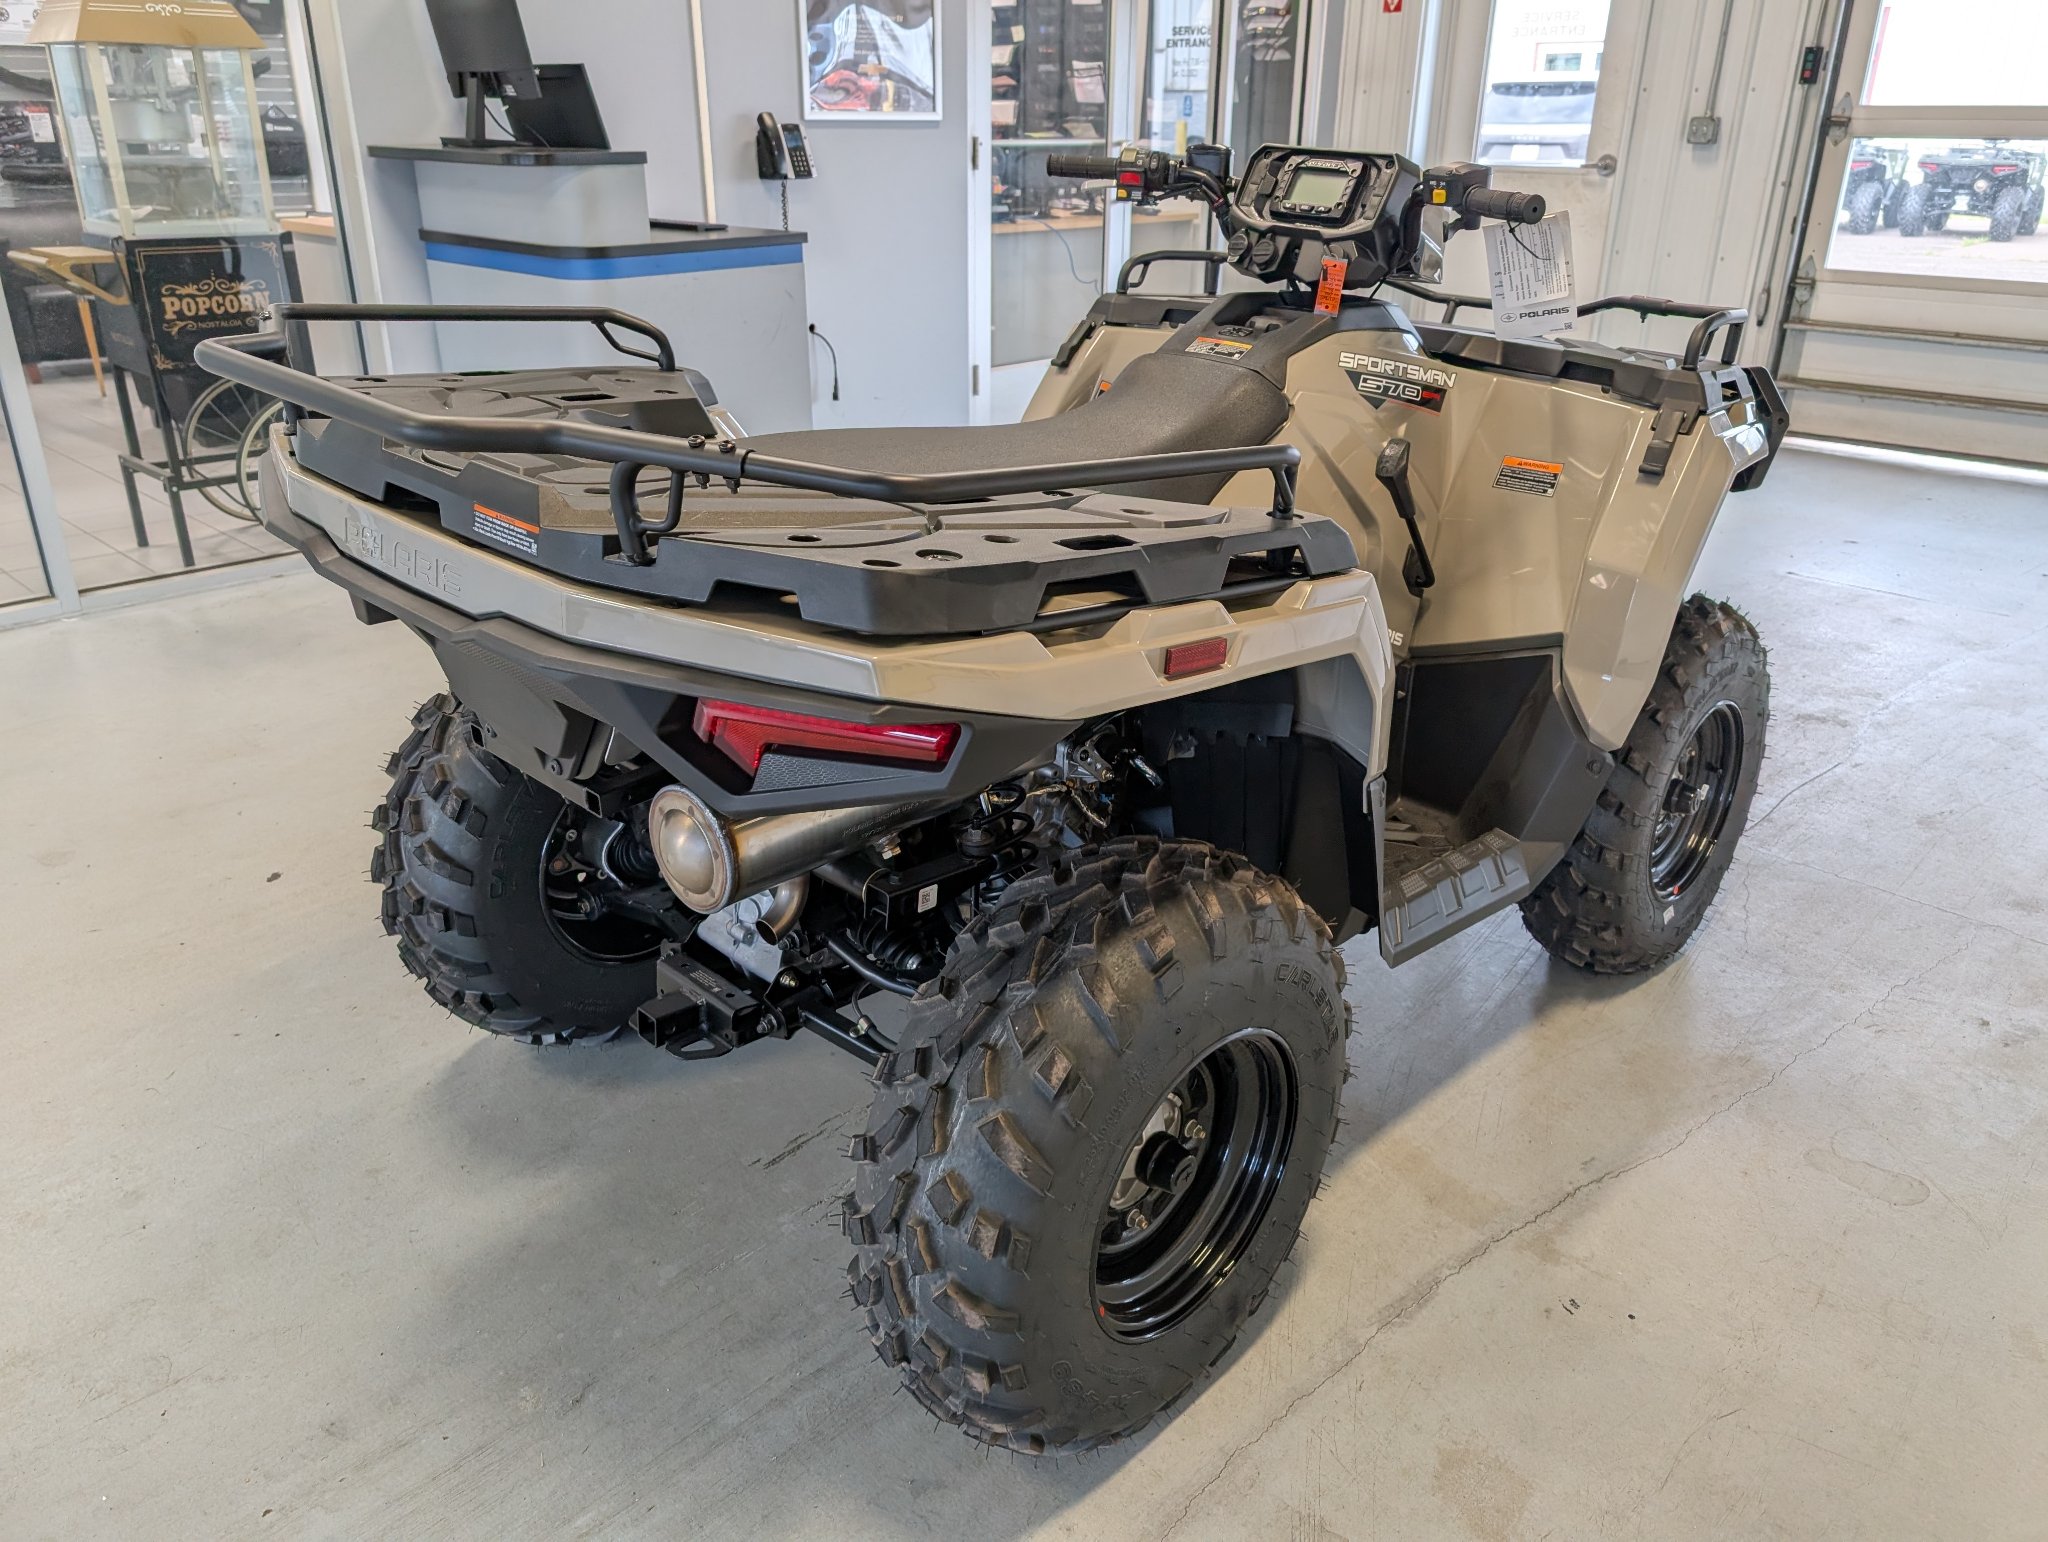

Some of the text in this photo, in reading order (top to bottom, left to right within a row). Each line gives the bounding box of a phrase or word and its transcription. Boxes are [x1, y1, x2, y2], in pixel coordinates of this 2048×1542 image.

[161, 290, 271, 320] POPCORN
[1519, 307, 1571, 319] POLARIS
[1338, 351, 1457, 388] SPORTSMAN
[1358, 374, 1422, 401] 570
[1522, 461, 1550, 470] WARNING
[345, 517, 463, 598] POLARIS
